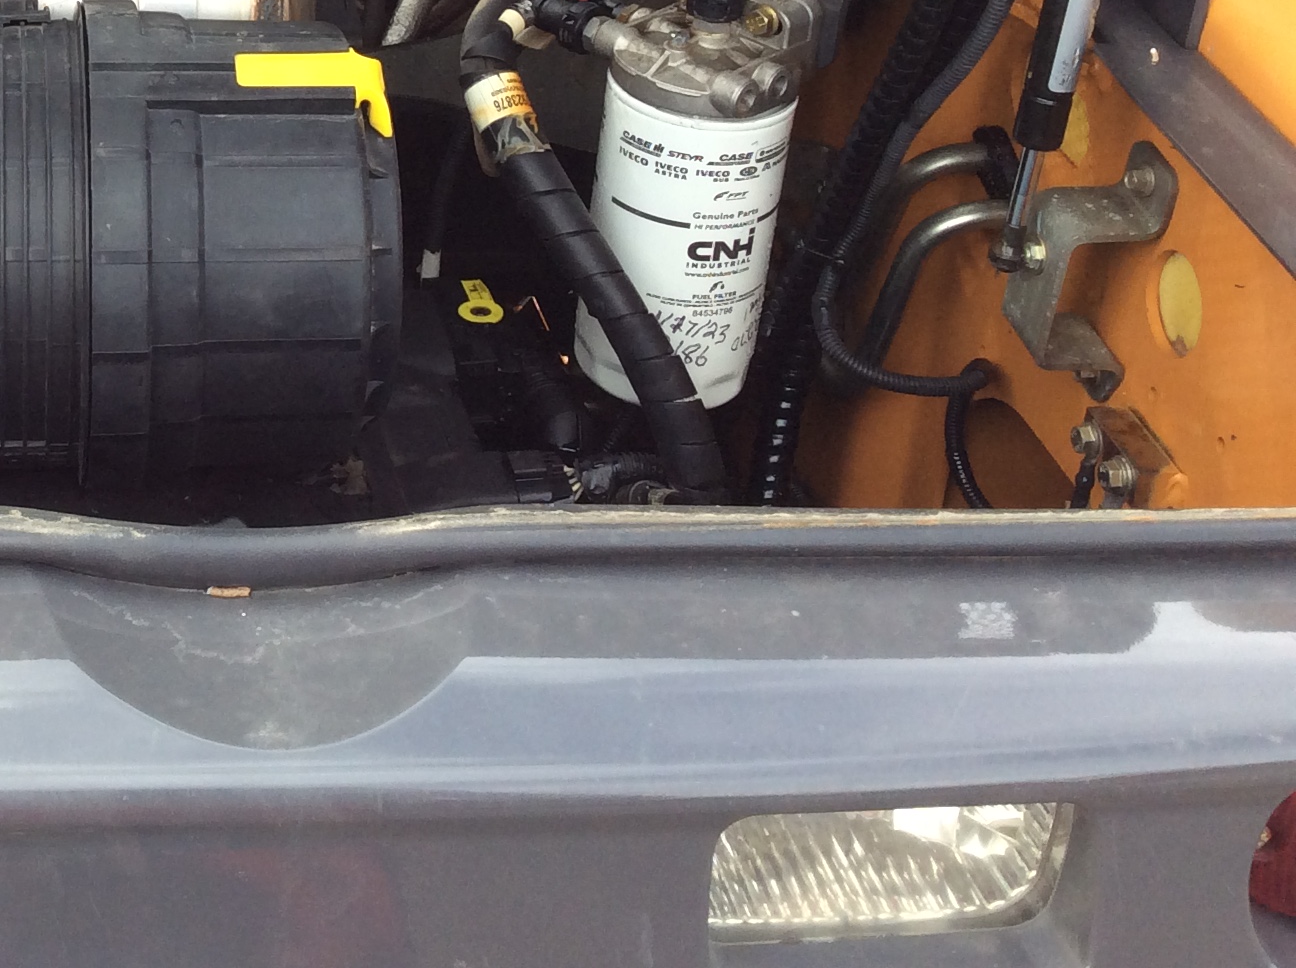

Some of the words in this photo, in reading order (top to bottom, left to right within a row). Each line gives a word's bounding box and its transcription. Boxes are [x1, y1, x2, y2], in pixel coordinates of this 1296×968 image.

[622, 130, 653, 149] CASE
[667, 150, 704, 163] STEYR
[719, 151, 754, 162] CASE
[619, 145, 649, 167] IVECO
[655, 160, 689, 175] IVECO
[695, 169, 731, 178] IVECO
[654, 168, 687, 181] ASTRA
[692, 211, 735, 221] Genuine
[737, 208, 759, 218] Parts
[705, 218, 756, 231] PERFORMANCE
[686, 256, 751, 269] INDUSTRIAL
